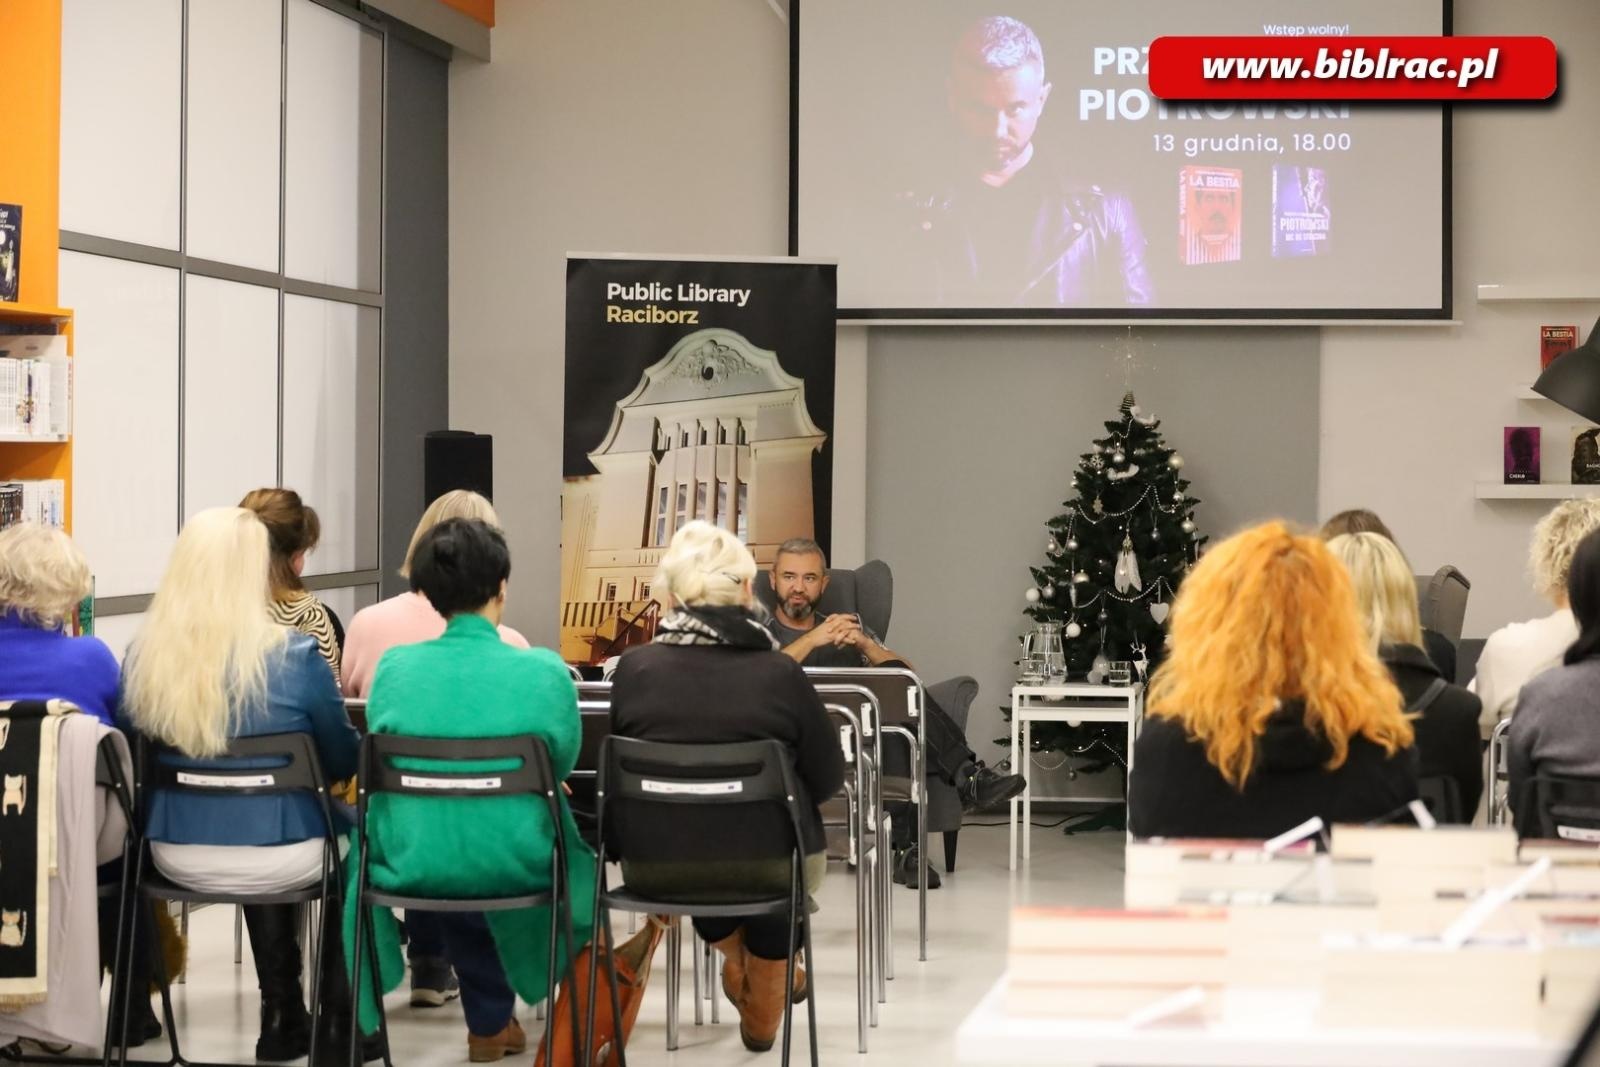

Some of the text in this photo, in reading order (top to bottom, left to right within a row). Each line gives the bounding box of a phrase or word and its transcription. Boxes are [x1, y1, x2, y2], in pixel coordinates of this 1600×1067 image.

[1307, 24, 1349, 37] wolny!
[1153, 133, 1351, 157] 13 grudnia, 18.00
[606, 282, 751, 307] Public Library
[606, 304, 699, 324] Raciborz
